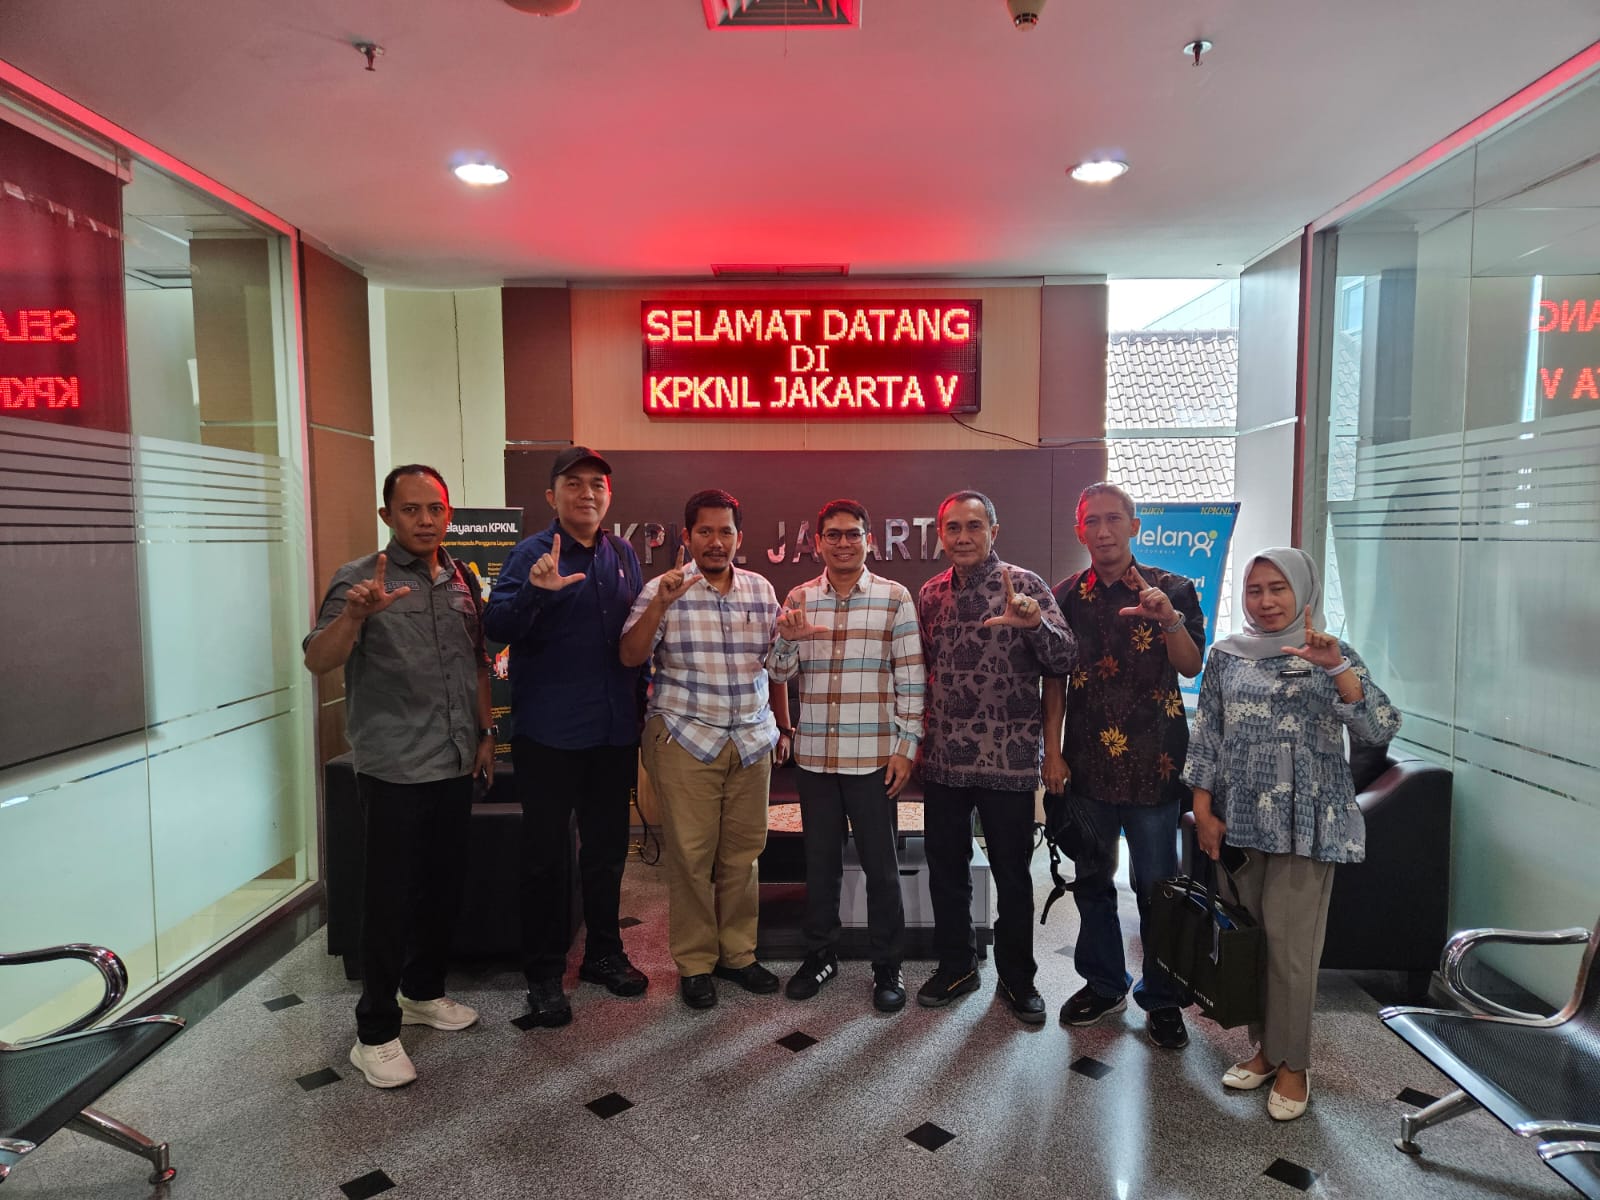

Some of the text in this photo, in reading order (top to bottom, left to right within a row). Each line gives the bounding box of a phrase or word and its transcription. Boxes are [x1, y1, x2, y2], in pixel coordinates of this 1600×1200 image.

[647, 308, 970, 342] SELAMAT DATANG
[791, 345, 829, 372] DI
[649, 374, 958, 408] KPKNL JAKARTA V
[488, 522, 518, 533] KPKNL
